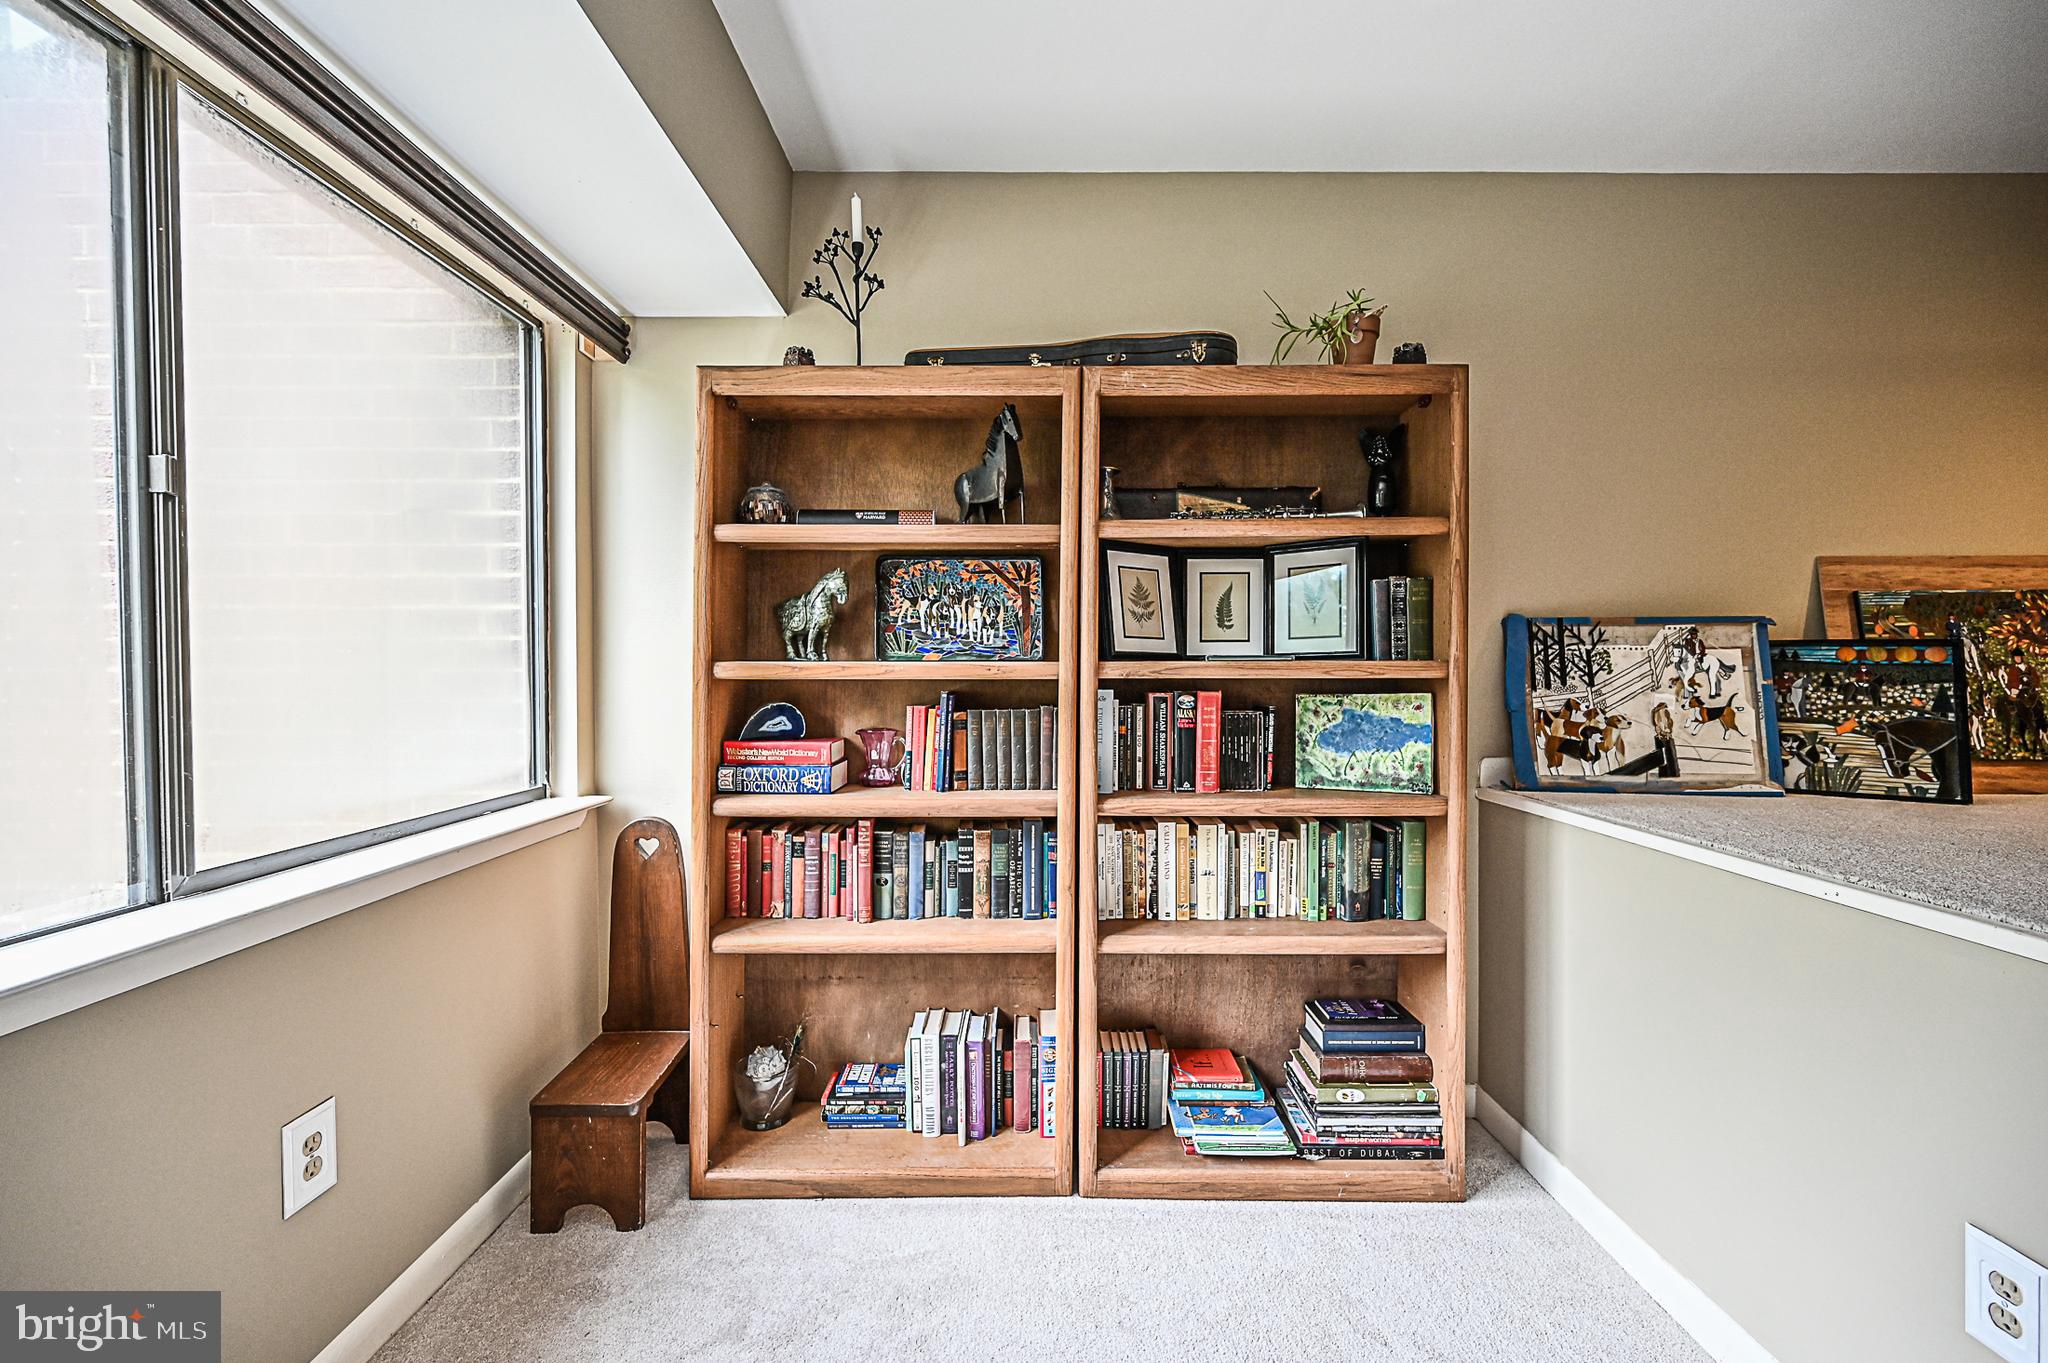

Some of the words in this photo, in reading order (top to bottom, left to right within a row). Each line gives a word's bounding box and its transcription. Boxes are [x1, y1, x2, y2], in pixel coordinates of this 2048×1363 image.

[744, 767, 799, 781] OXFORD
[744, 782, 798, 792] DICTIONARY
[1010, 861, 1015, 870] OF
[926, 1106, 935, 1134] AUDITION
